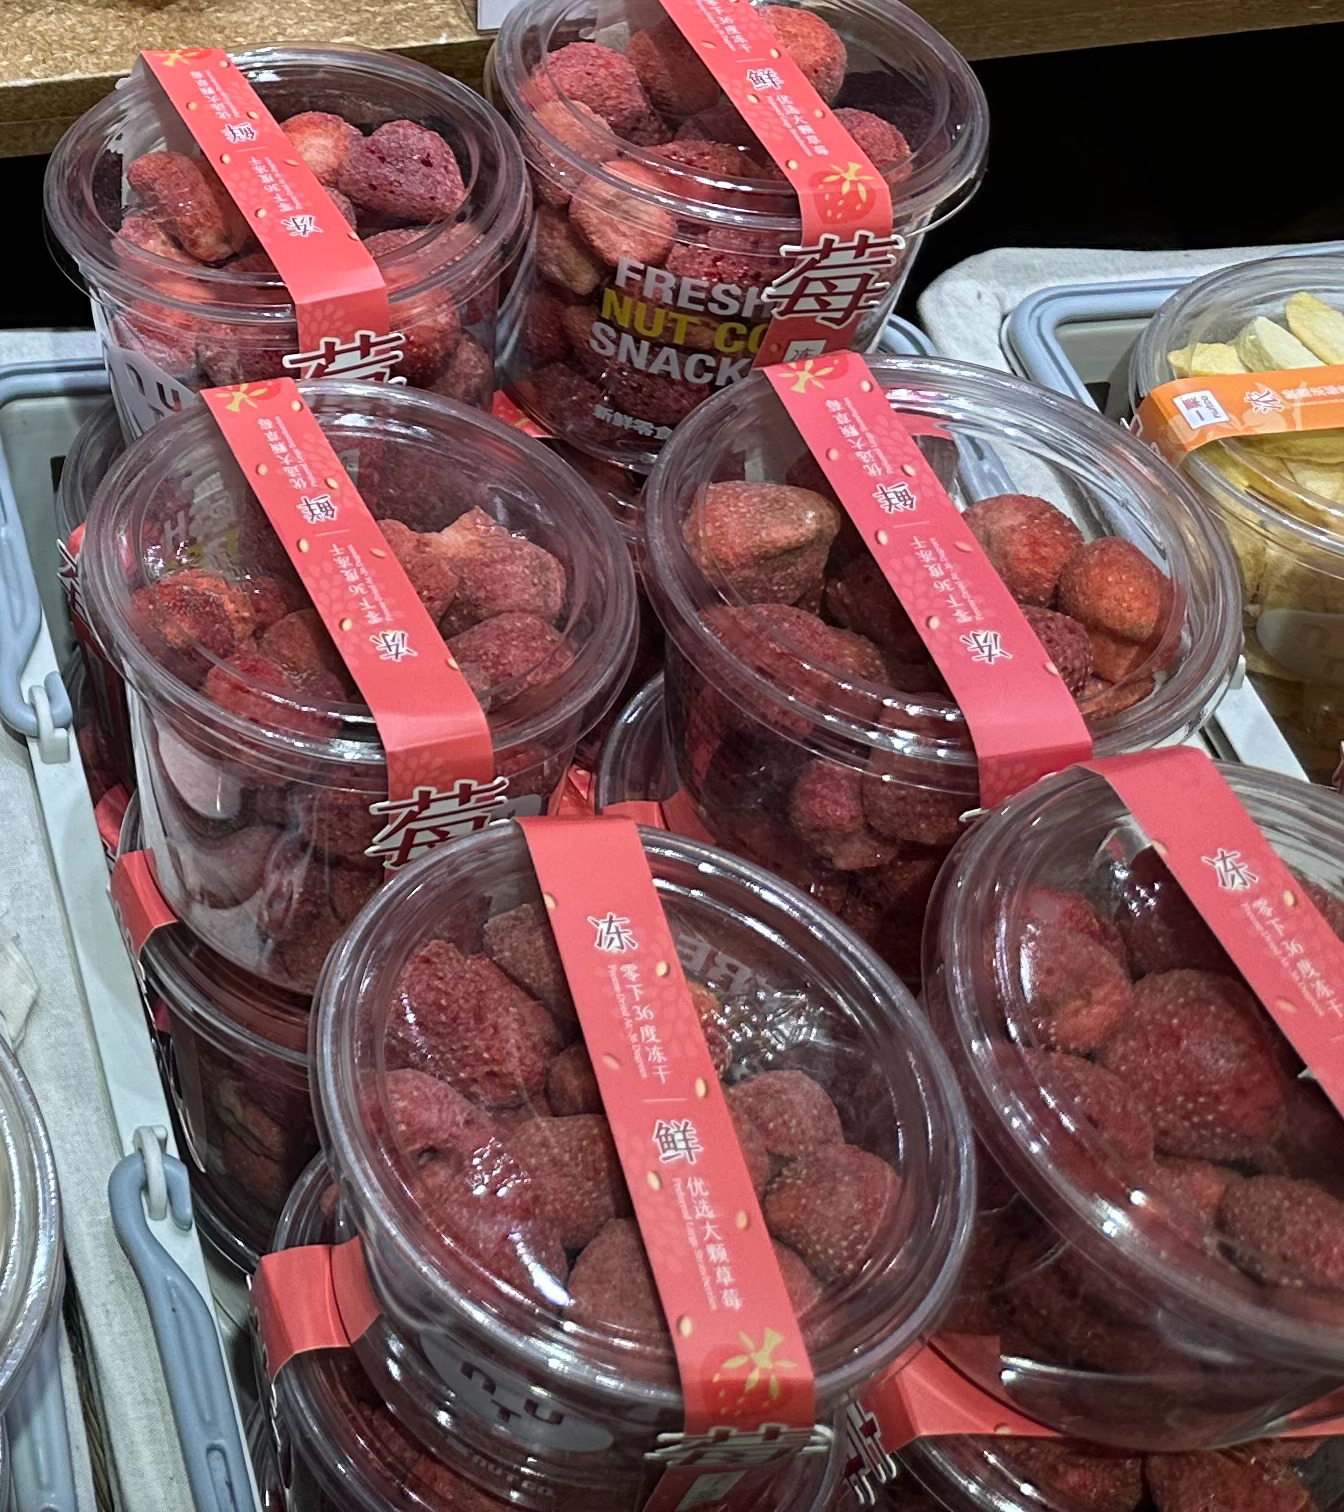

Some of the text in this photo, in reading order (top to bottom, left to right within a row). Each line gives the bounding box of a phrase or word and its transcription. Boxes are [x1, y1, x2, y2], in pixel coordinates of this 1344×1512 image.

[614, 257, 779, 320] FRESH
[762, 230, 905, 329] 莓
[601, 288, 699, 344] NUT
[588, 321, 752, 387] SNACK
[296, 493, 338, 525] 鲜
[872, 481, 918, 514] 鲜
[369, 629, 418, 662] 冻
[959, 630, 1013, 665] 冻
[1201, 847, 1259, 891] 冻
[587, 912, 639, 953] 冻
[652, 1119, 703, 1164] 鲜
